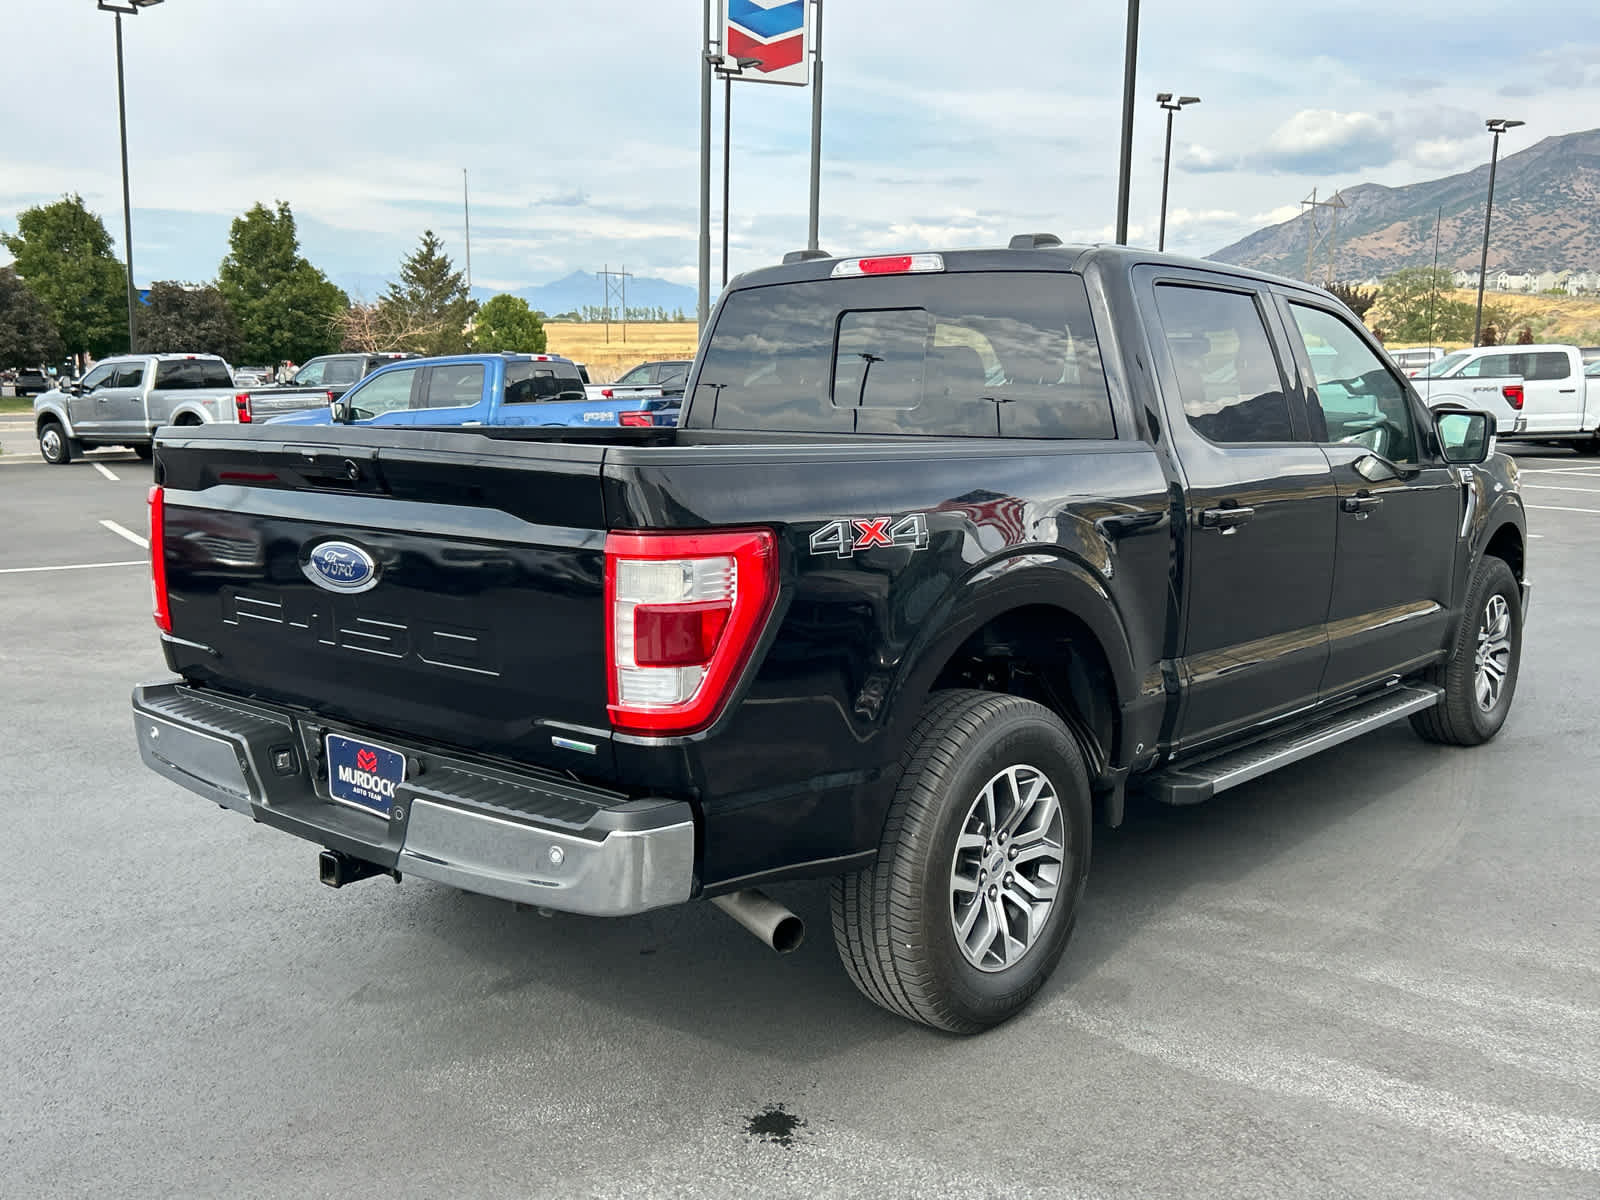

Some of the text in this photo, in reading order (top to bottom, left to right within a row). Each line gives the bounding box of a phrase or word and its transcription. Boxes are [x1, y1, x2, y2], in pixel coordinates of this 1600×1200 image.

[321, 550, 356, 577] Ford
[338, 764, 396, 799] MURDOCK
[352, 786, 383, 802] AUTO TEAM
